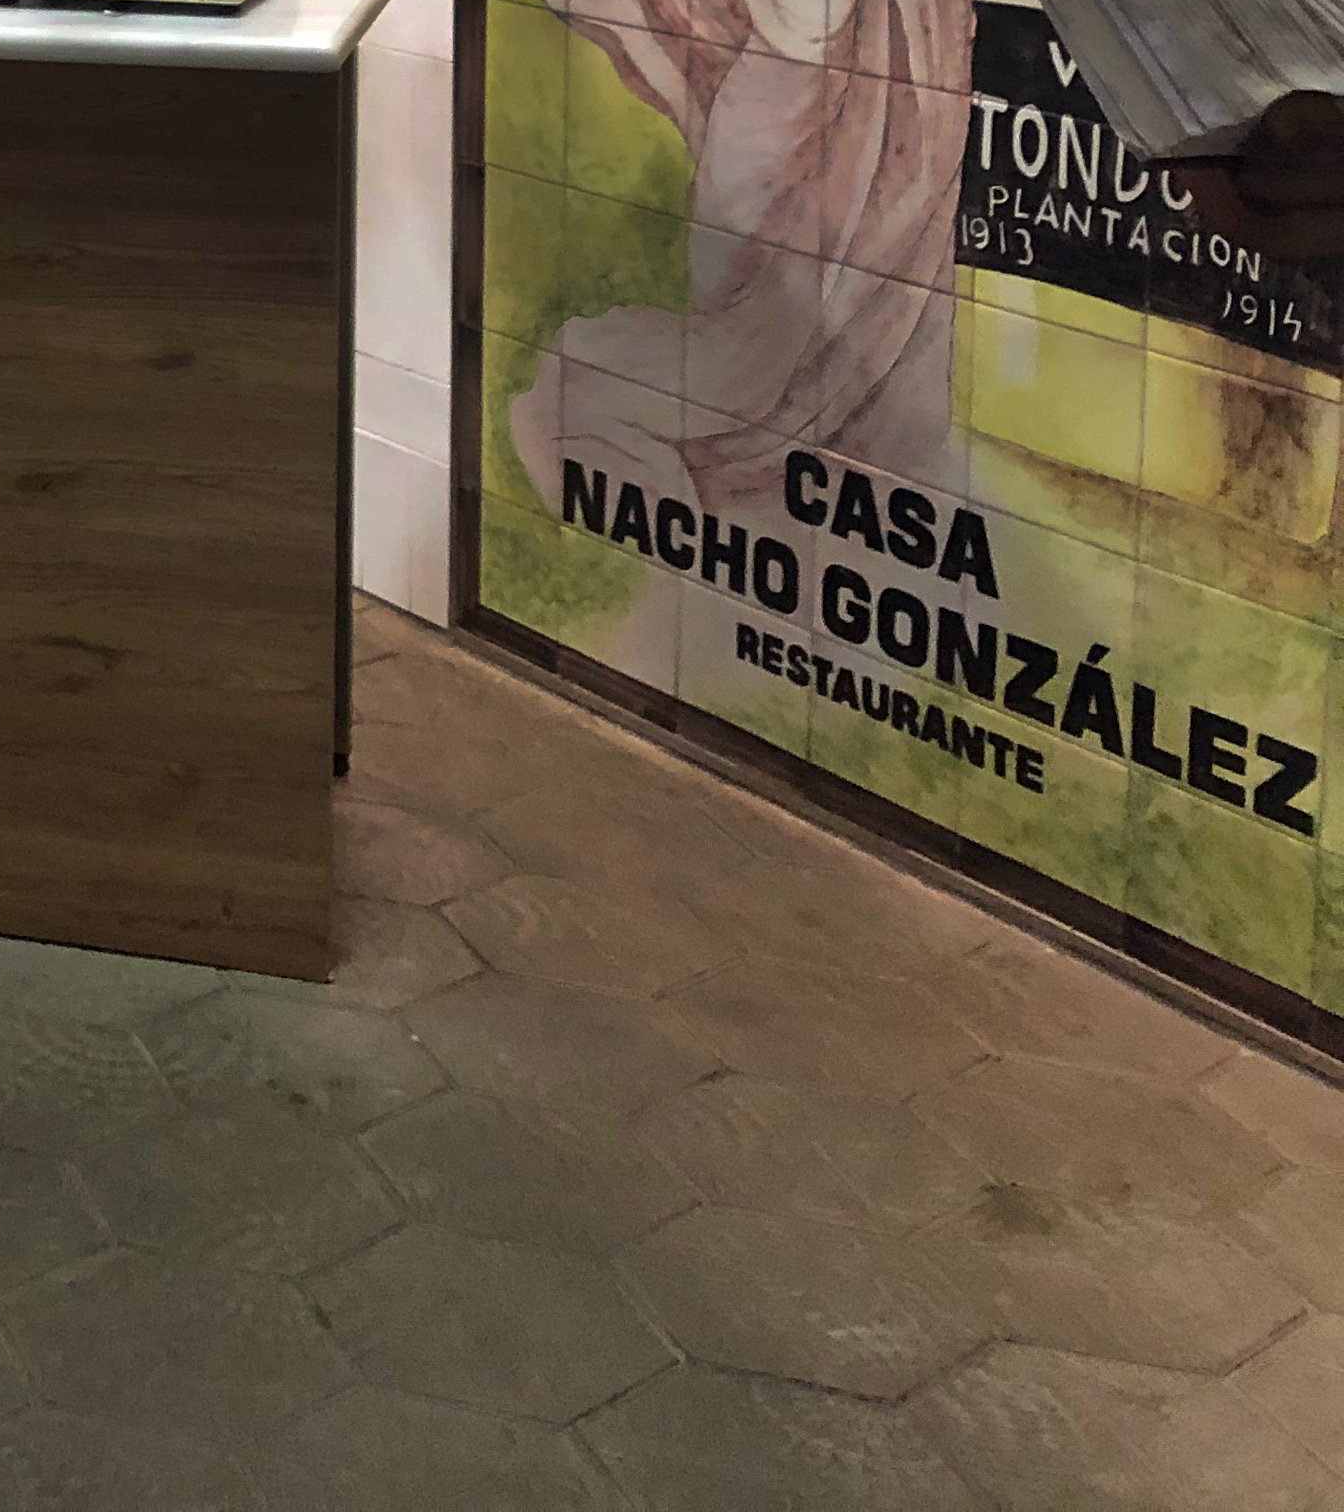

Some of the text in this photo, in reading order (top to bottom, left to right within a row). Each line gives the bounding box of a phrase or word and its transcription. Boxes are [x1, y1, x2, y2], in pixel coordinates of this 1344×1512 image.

[961, 215, 1035, 266] 1913
[988, 185, 1262, 283] PLANTACION
[1221, 290, 1303, 343] 1914
[783, 449, 1000, 600] CASA
[562, 458, 1319, 836] NACHO GONZÁLEZ
[735, 622, 1046, 795] RESTAURANTE
